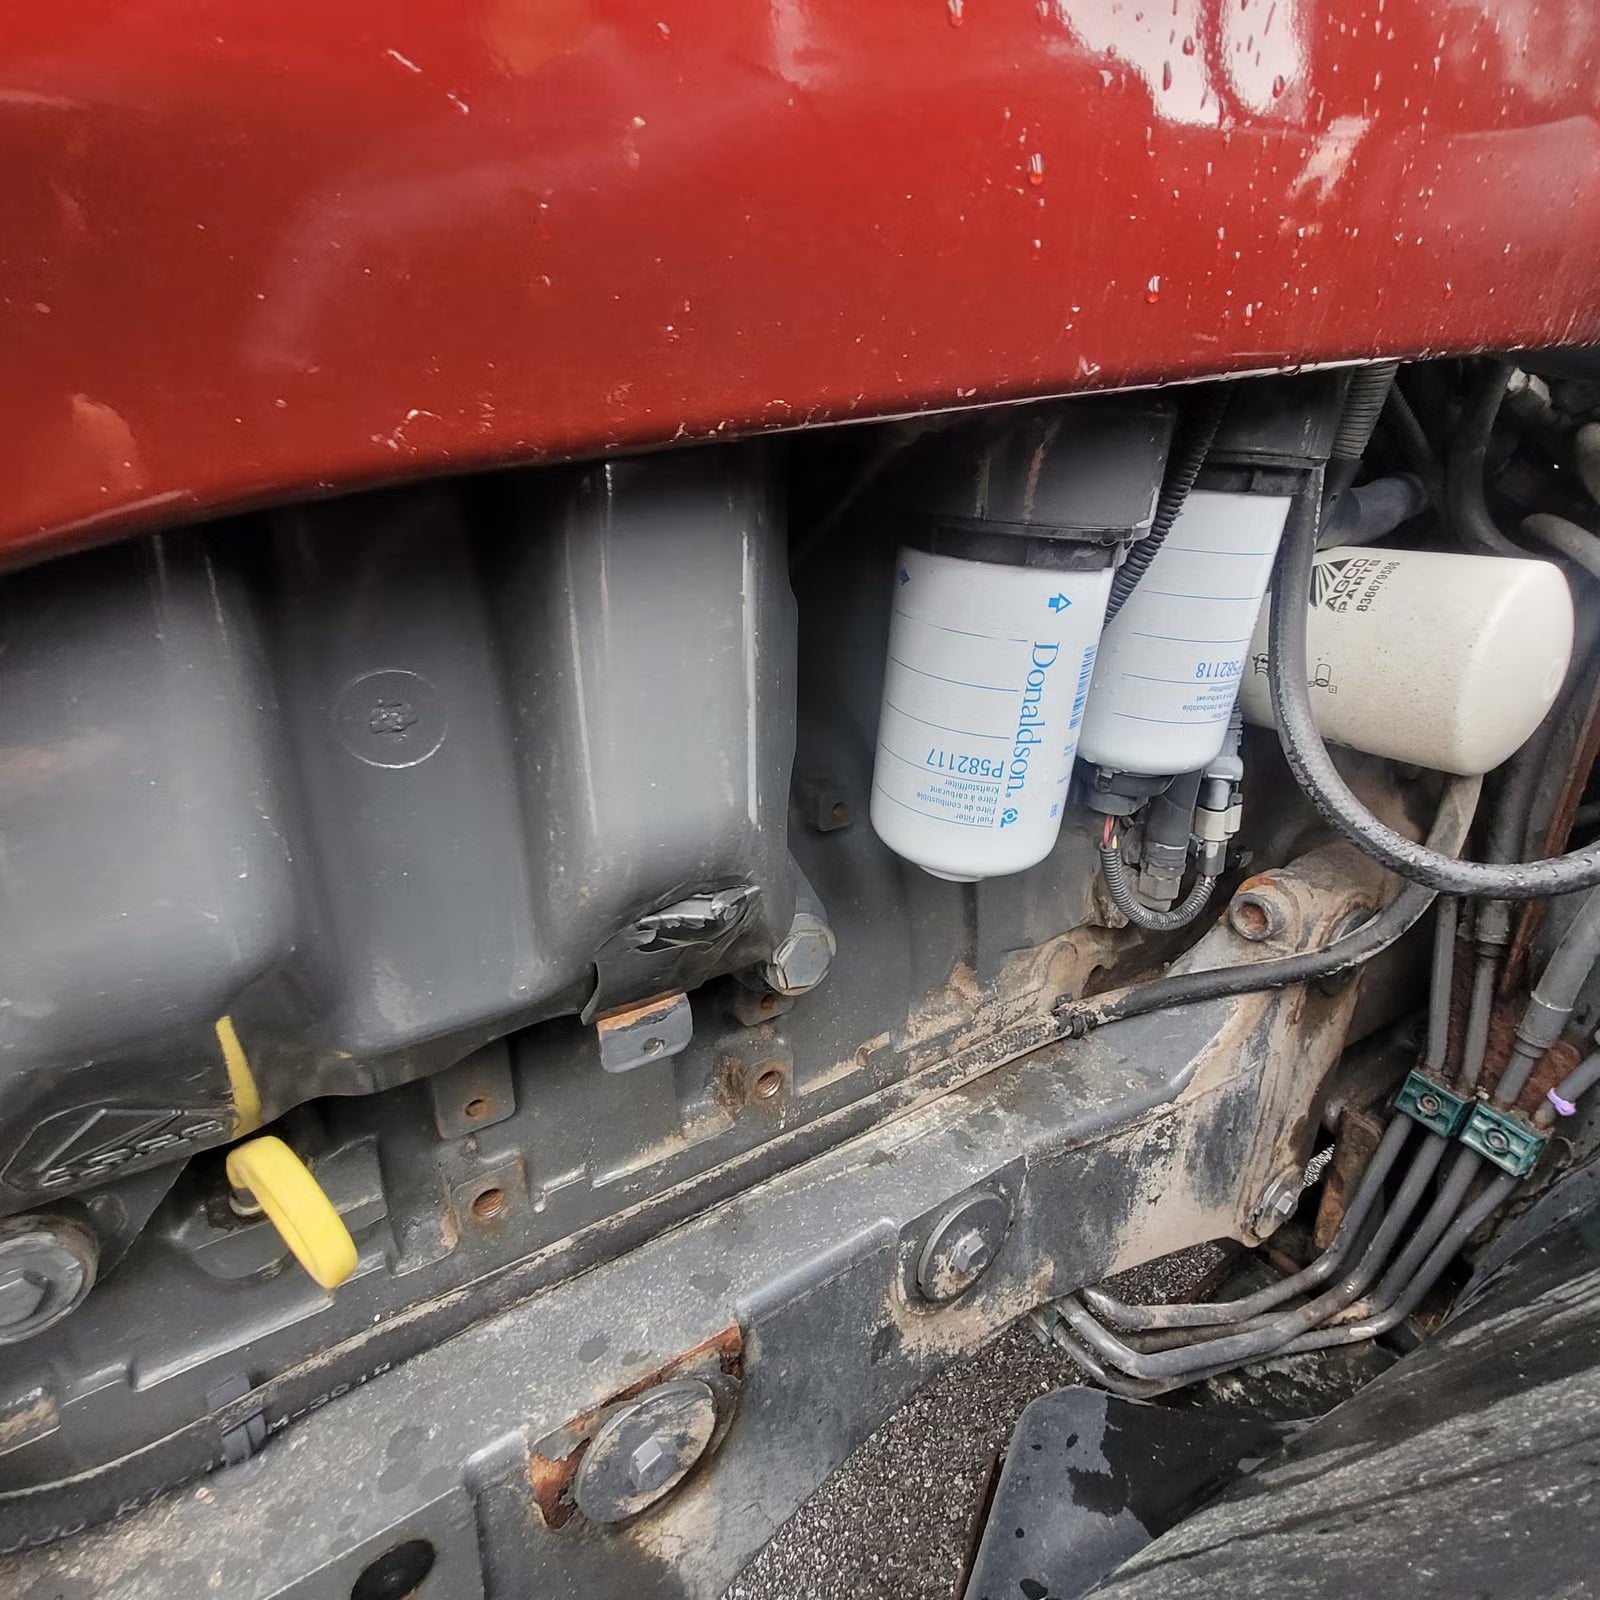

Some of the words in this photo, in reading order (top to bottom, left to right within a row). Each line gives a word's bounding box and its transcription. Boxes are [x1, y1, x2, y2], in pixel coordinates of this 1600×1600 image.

[1325, 559, 1370, 612] AGCO
[1336, 559, 1381, 613] PARTS
[1007, 641, 1060, 793] Donaldson
[926, 749, 1004, 778] P582117
[930, 785, 968, 800] carburant
[955, 812, 975, 824] Filter
[963, 803, 974, 812] de
[977, 816, 994, 825] Fuel
